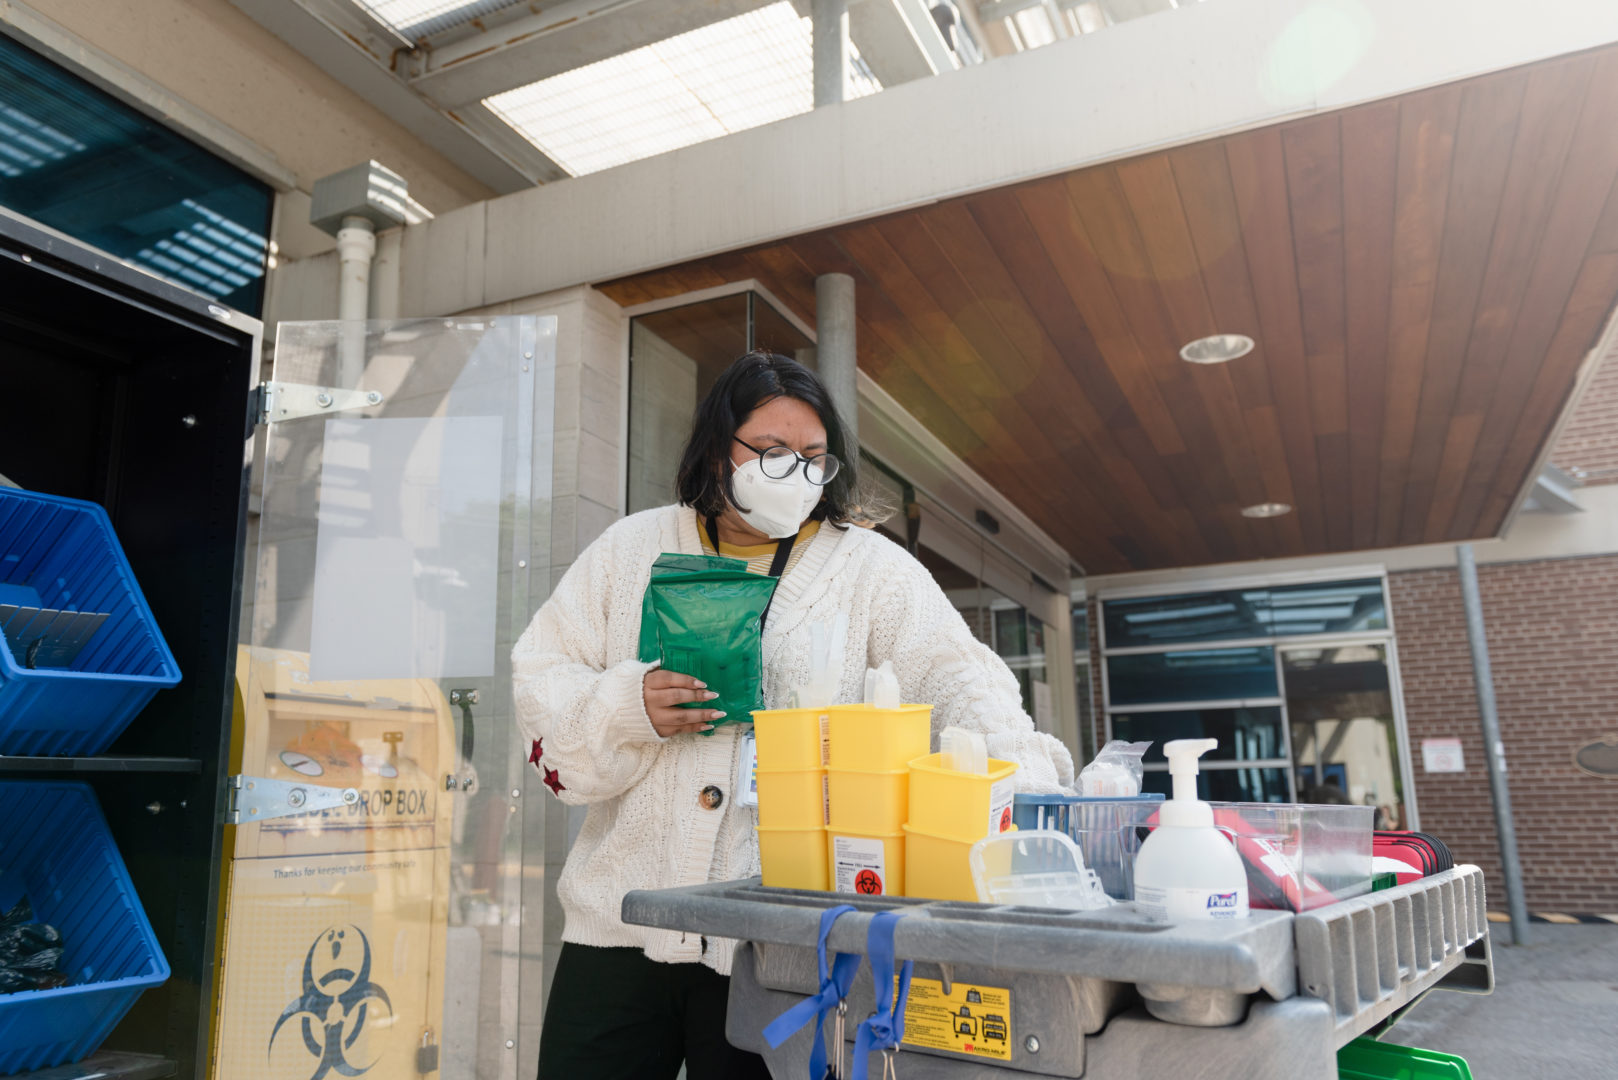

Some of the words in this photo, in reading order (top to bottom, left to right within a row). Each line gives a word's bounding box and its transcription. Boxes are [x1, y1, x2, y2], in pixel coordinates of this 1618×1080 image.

[396, 790, 428, 815] BOX
[273, 868, 302, 879] Thanks
[303, 867, 316, 876] for
[318, 866, 347, 875] keeping
